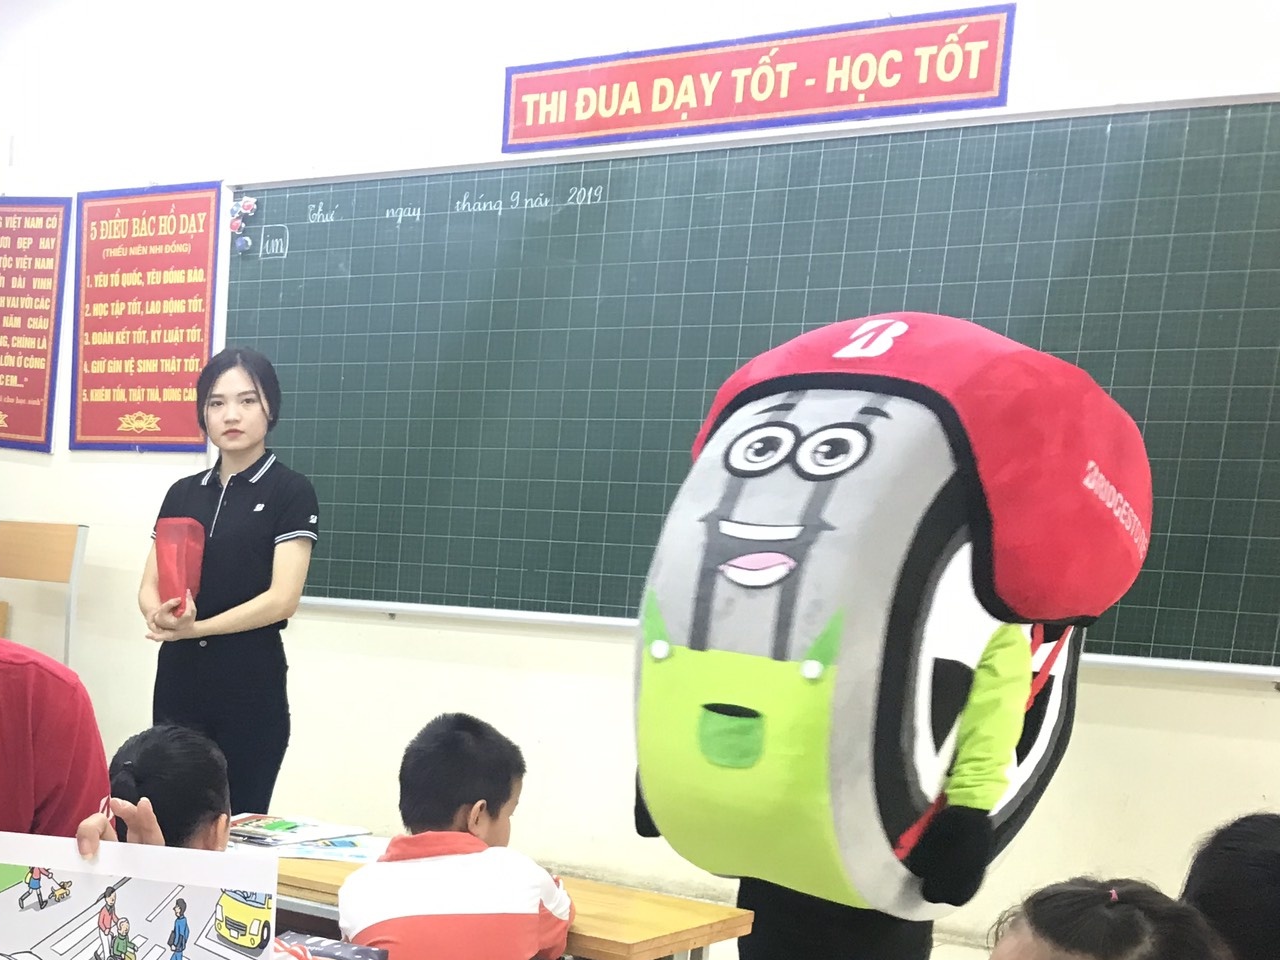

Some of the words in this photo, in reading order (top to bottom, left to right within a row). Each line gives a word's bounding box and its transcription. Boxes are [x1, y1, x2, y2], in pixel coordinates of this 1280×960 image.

[522, 91, 566, 127] THI
[575, 81, 642, 122] ĐUA
[652, 70, 723, 120] DẠY
[732, 49, 797, 104] TỐT
[826, 49, 904, 104] HỌC
[914, 24, 990, 85] TỐT
[455, 191, 503, 216] tháng
[510, 190, 520, 209] 9
[567, 185, 603, 205] 2019
[5, 214, 22, 231] VIỆT
[24, 216, 44, 229] NAM
[45, 214, 58, 229] CÓ
[90, 221, 97, 241] 5
[100, 207, 129, 240] ĐIỀU
[131, 209, 156, 238] BÁC
[157, 203, 177, 236] HỒ
[179, 212, 207, 240] DẠY
[16, 236, 33, 252] ĐẸP
[39, 237, 56, 249] HAY
[129, 244, 148, 256] NIÊN
[149, 244, 163, 255] NHI
[15, 254, 33, 272] VIỆT
[34, 257, 55, 270] NAM
[32, 277, 53, 290] VINH
[94, 271, 109, 287] YÊU
[147, 268, 162, 285] YÊU
[6, 295, 19, 308] VAI
[20, 294, 34, 309] VỚI
[33, 295, 51, 310] CÁC
[92, 303, 109, 320] HỌC
[111, 299, 126, 319] TẬP
[145, 300, 161, 315] LAO
[163, 297, 186, 317] ĐỘNG
[2, 313, 21, 328] NĂM
[27, 315, 49, 330] CHÂU
[11, 334, 36, 349] CHÍNH
[36, 335, 47, 350] LÀ
[91, 328, 114, 345] ĐOÀN
[115, 326, 130, 345] KẾT
[163, 326, 185, 346] LUẬT
[0, 352, 16, 367] LỚN
[23, 355, 46, 369] CÔNG
[124, 356, 135, 376] VỆ
[136, 359, 158, 373] SINH
[160, 356, 182, 376] THẬT
[129, 385, 146, 404] THẬT
